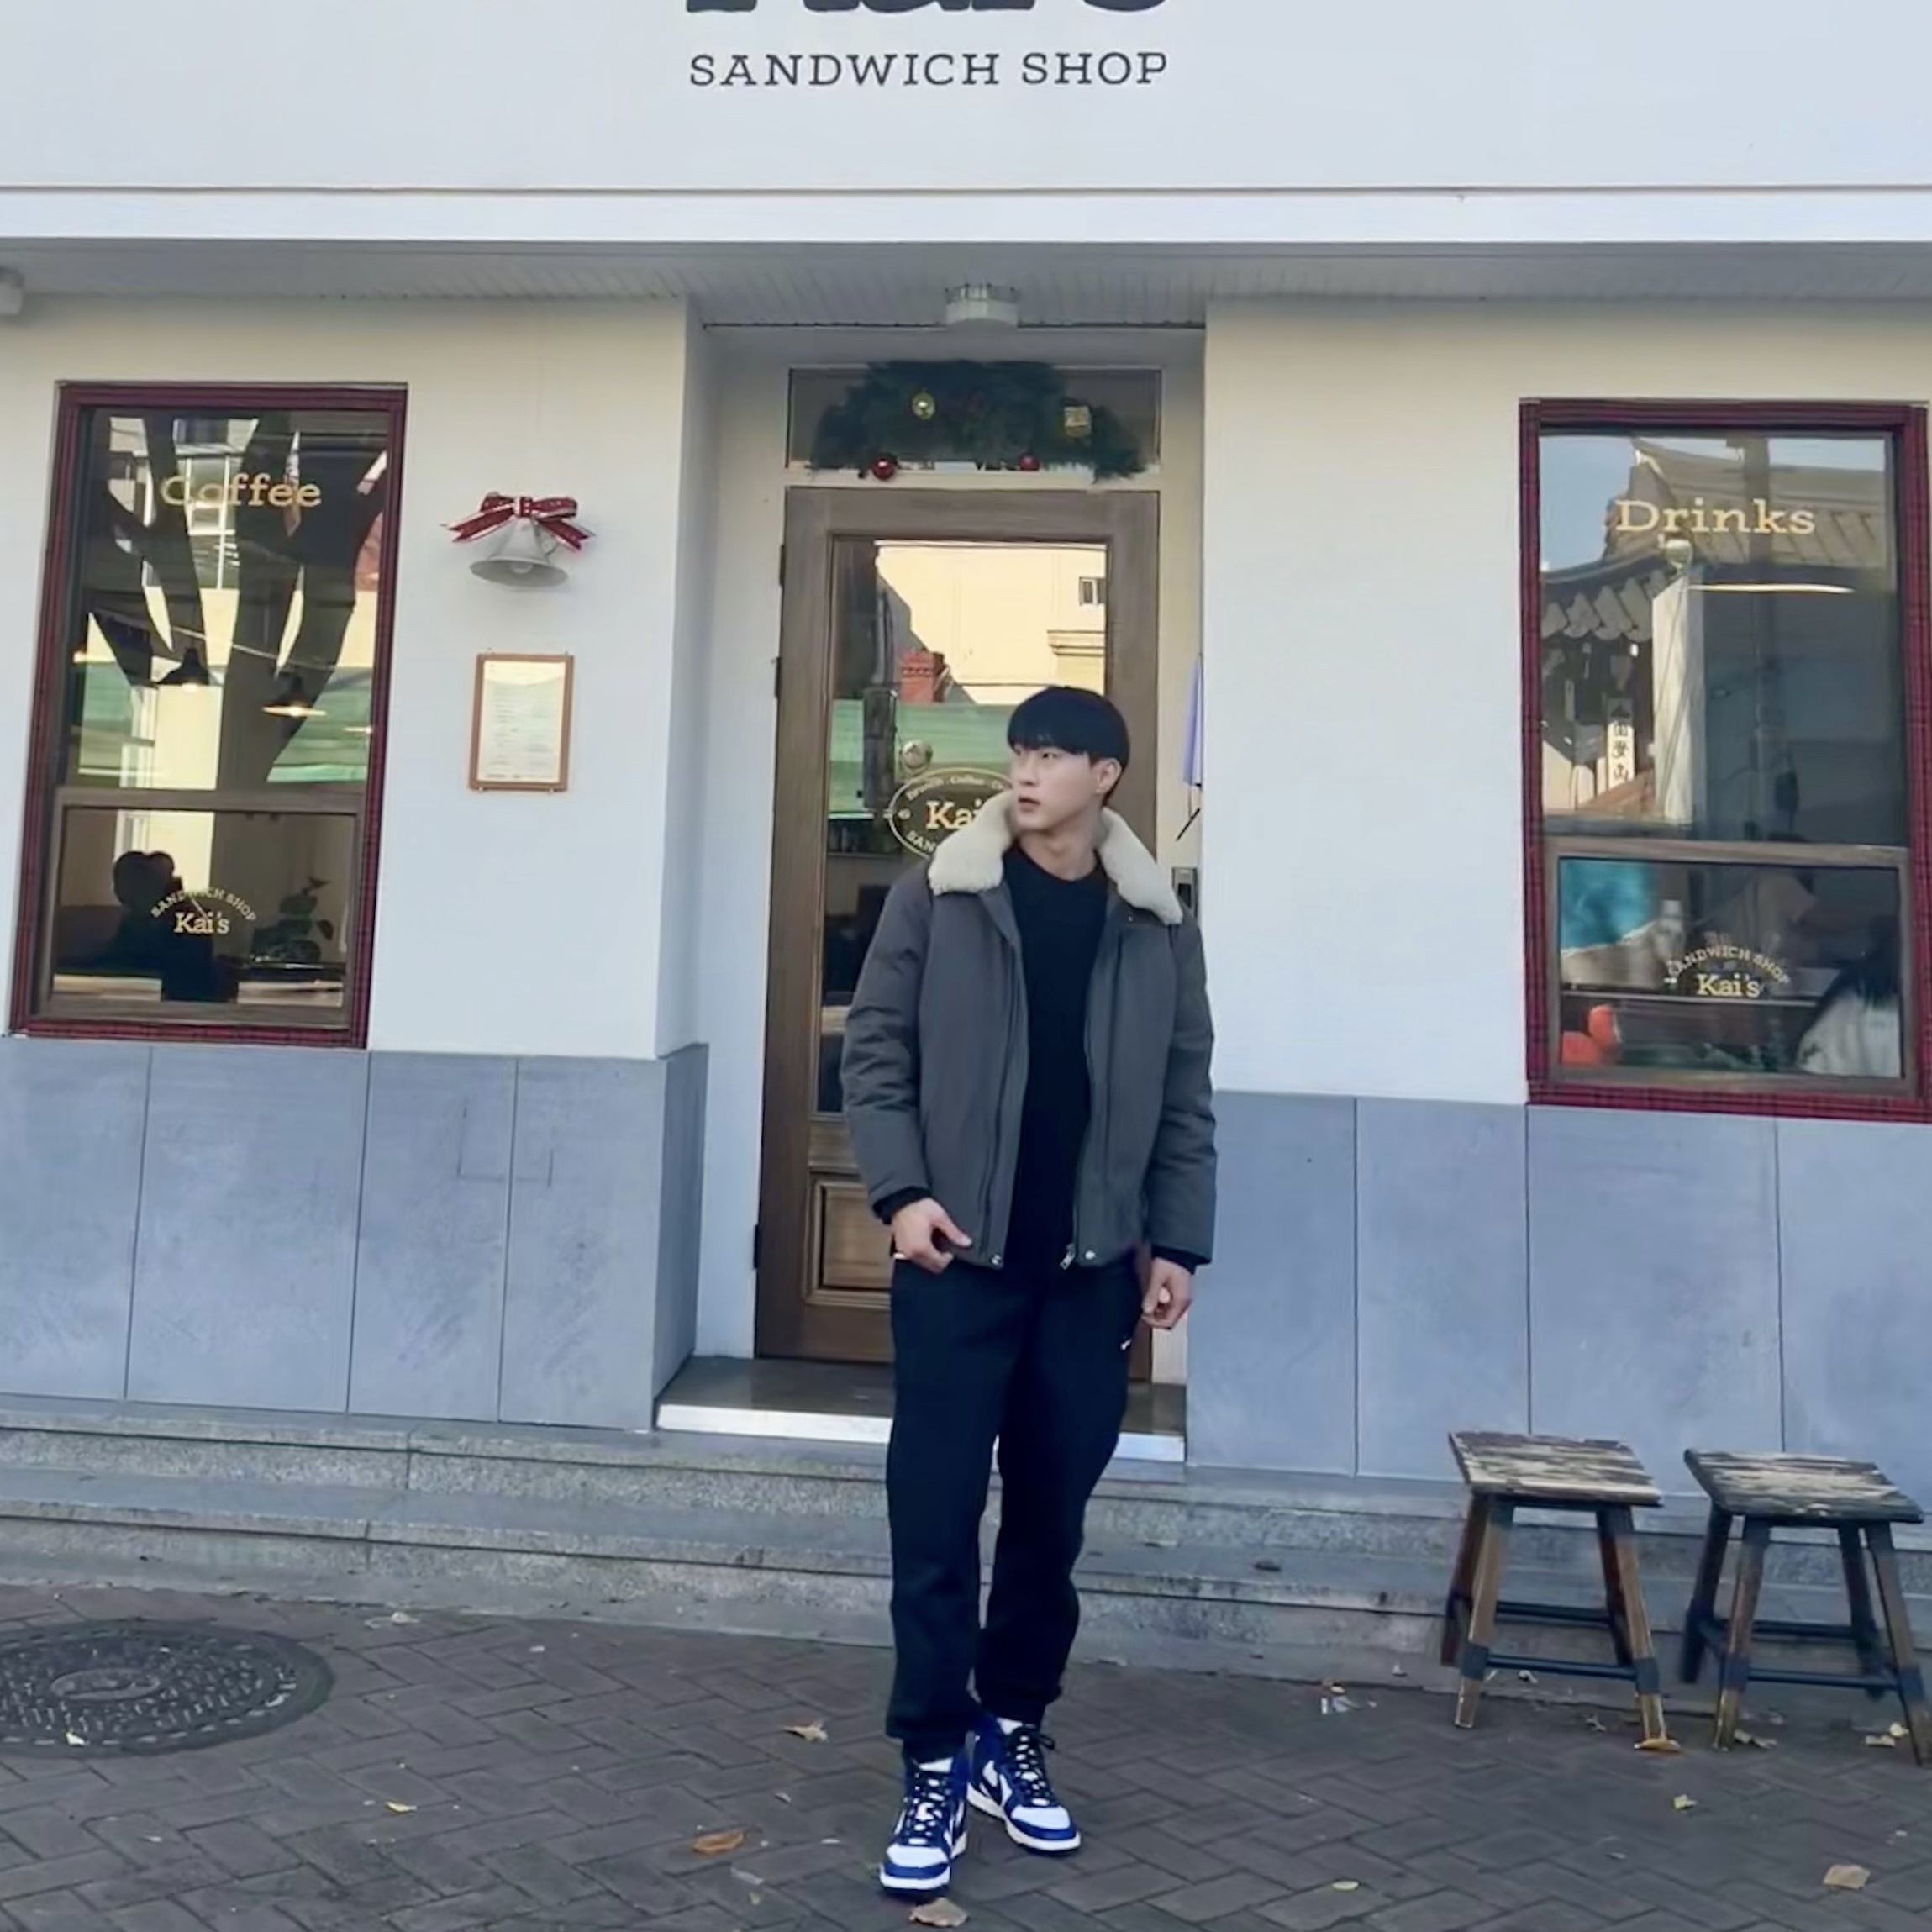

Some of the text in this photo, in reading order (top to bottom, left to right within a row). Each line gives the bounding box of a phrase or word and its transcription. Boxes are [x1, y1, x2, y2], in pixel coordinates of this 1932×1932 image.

[689, 52, 1167, 86] SANDWICH SHOP
[161, 472, 322, 507] Coffee
[1614, 497, 1816, 534] Drinks
[226, 892, 257, 920] SHOP
[173, 911, 230, 934] Kai's
[1697, 972, 1760, 998] Kai's
